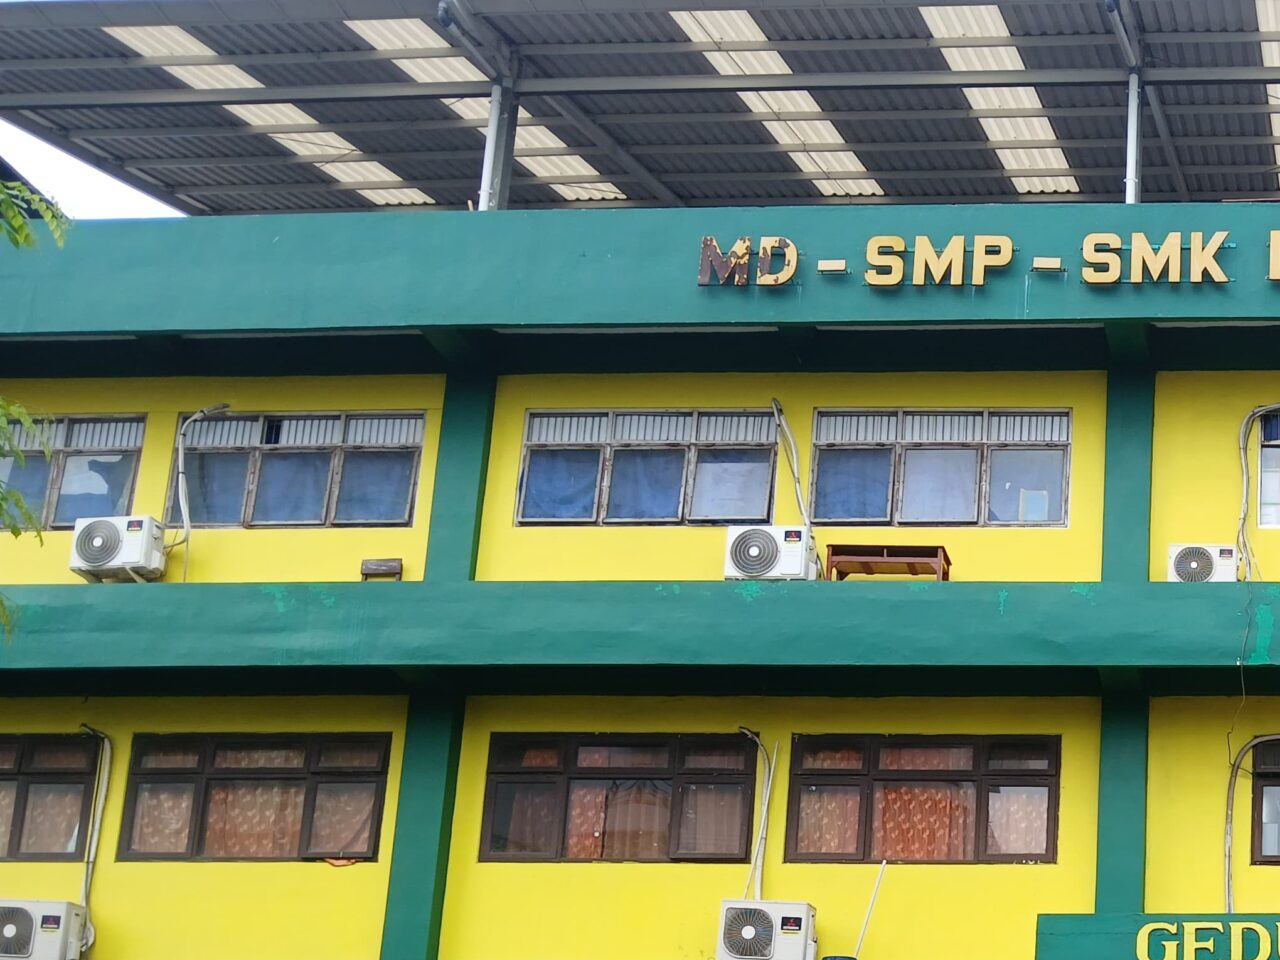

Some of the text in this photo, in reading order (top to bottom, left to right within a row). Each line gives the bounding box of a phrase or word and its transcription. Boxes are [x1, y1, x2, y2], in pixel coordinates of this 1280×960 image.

[698, 236, 798, 286] MD
[864, 235, 1013, 286] SMP
[1082, 231, 1229, 283] SMK
